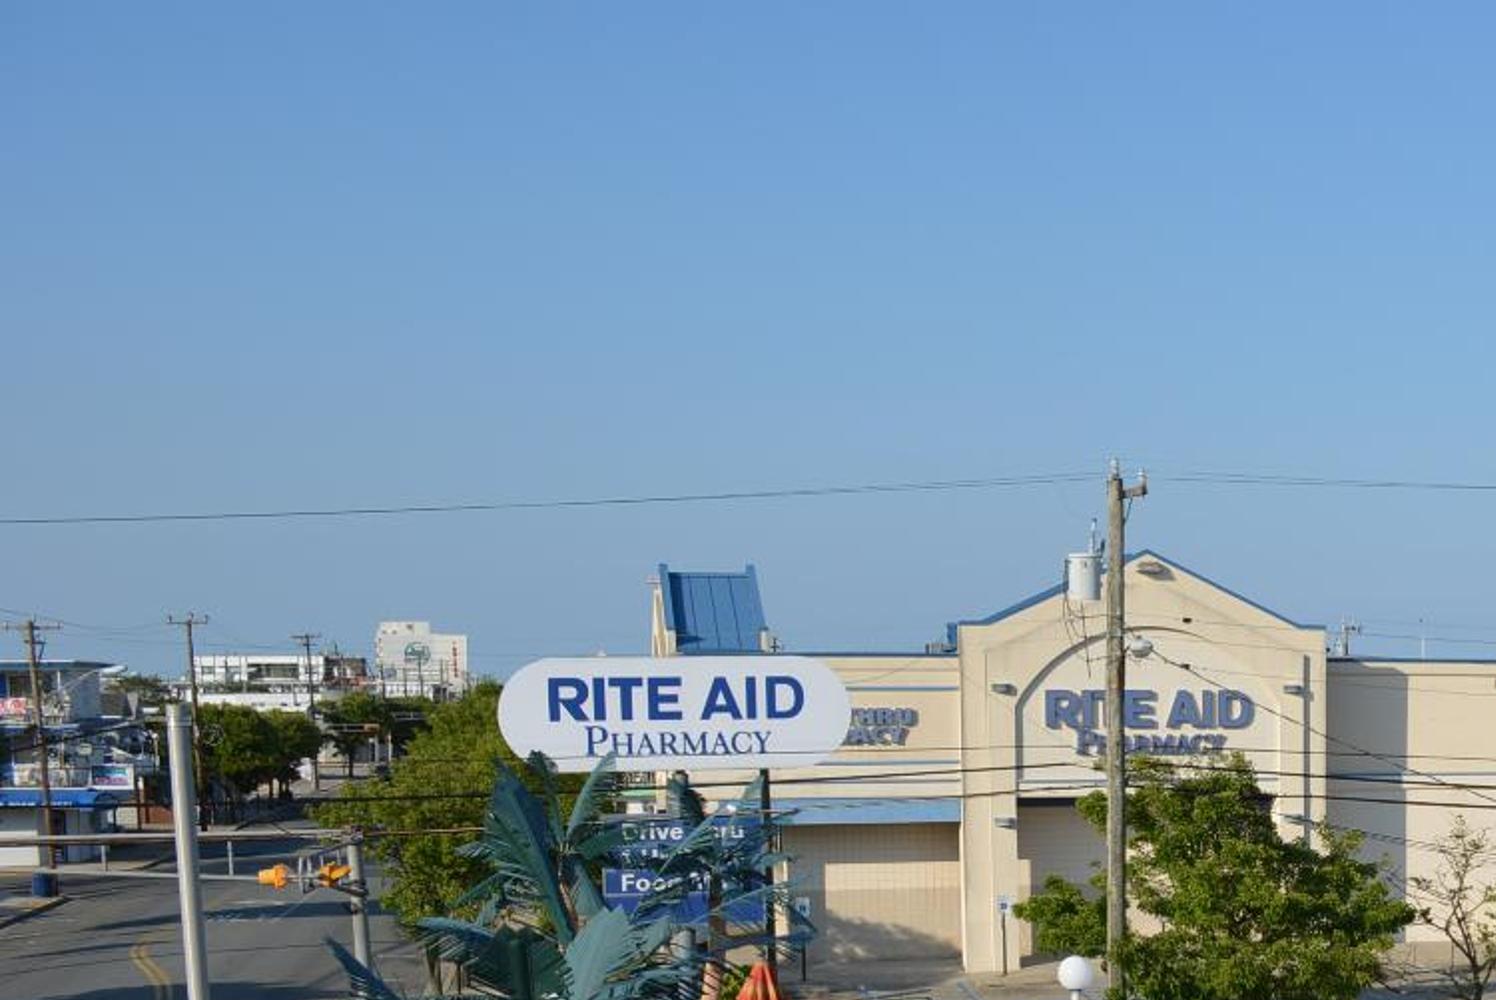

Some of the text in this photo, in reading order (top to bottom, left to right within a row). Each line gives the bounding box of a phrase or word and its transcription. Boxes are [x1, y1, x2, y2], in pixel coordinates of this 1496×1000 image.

[548, 676, 804, 722] RITE AID
[1166, 690, 1256, 730] AID
[587, 726, 771, 757] PHARMACY
[622, 873, 677, 892] Foo
